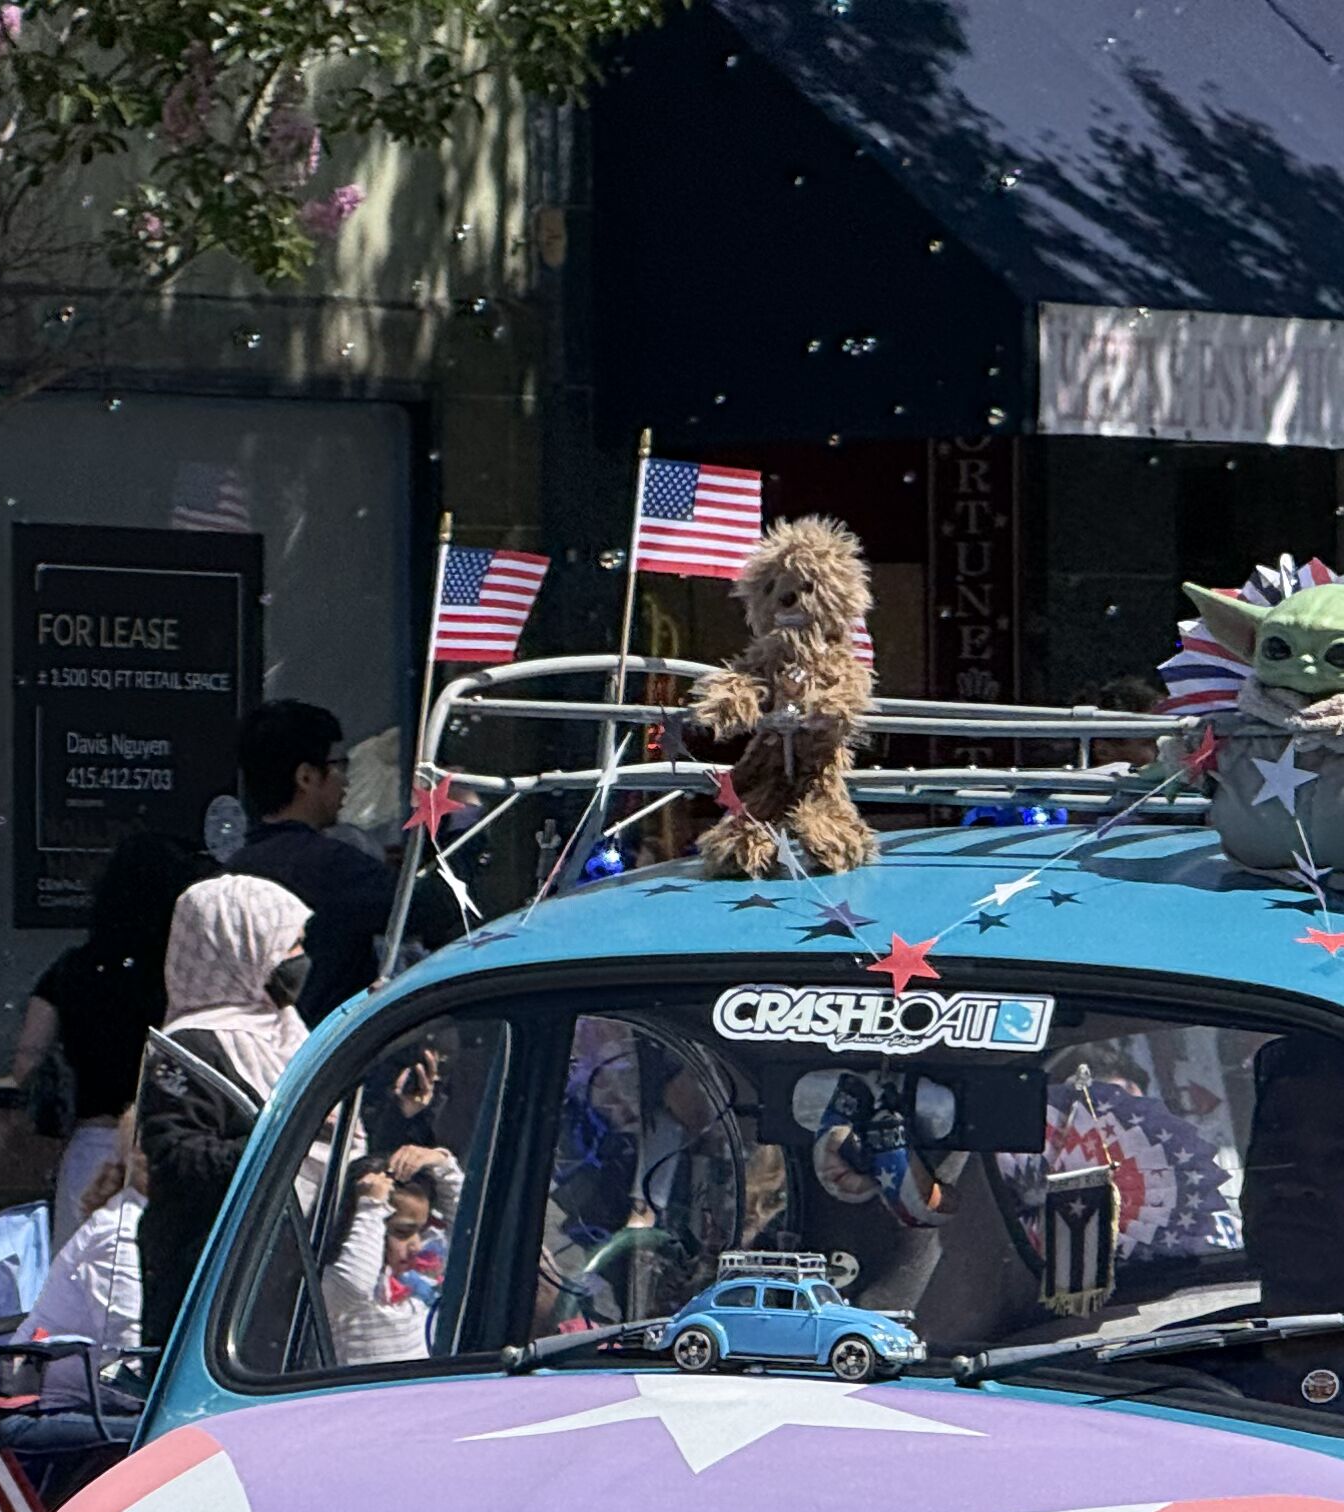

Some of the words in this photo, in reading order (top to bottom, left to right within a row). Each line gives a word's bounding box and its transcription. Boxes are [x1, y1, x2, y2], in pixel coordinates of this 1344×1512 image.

[955, 436, 994, 660] RTUNE
[38, 613, 93, 647] FOR
[99, 616, 180, 651] LEASE
[90, 669, 113, 690] SQ
[115, 670, 134, 688] FT
[135, 671, 183, 690] RETAIL
[184, 672, 232, 692] SPACE
[66, 732, 107, 754] Davis
[112, 733, 170, 760] Nguyen
[66, 767, 172, 791] 415.412.5703
